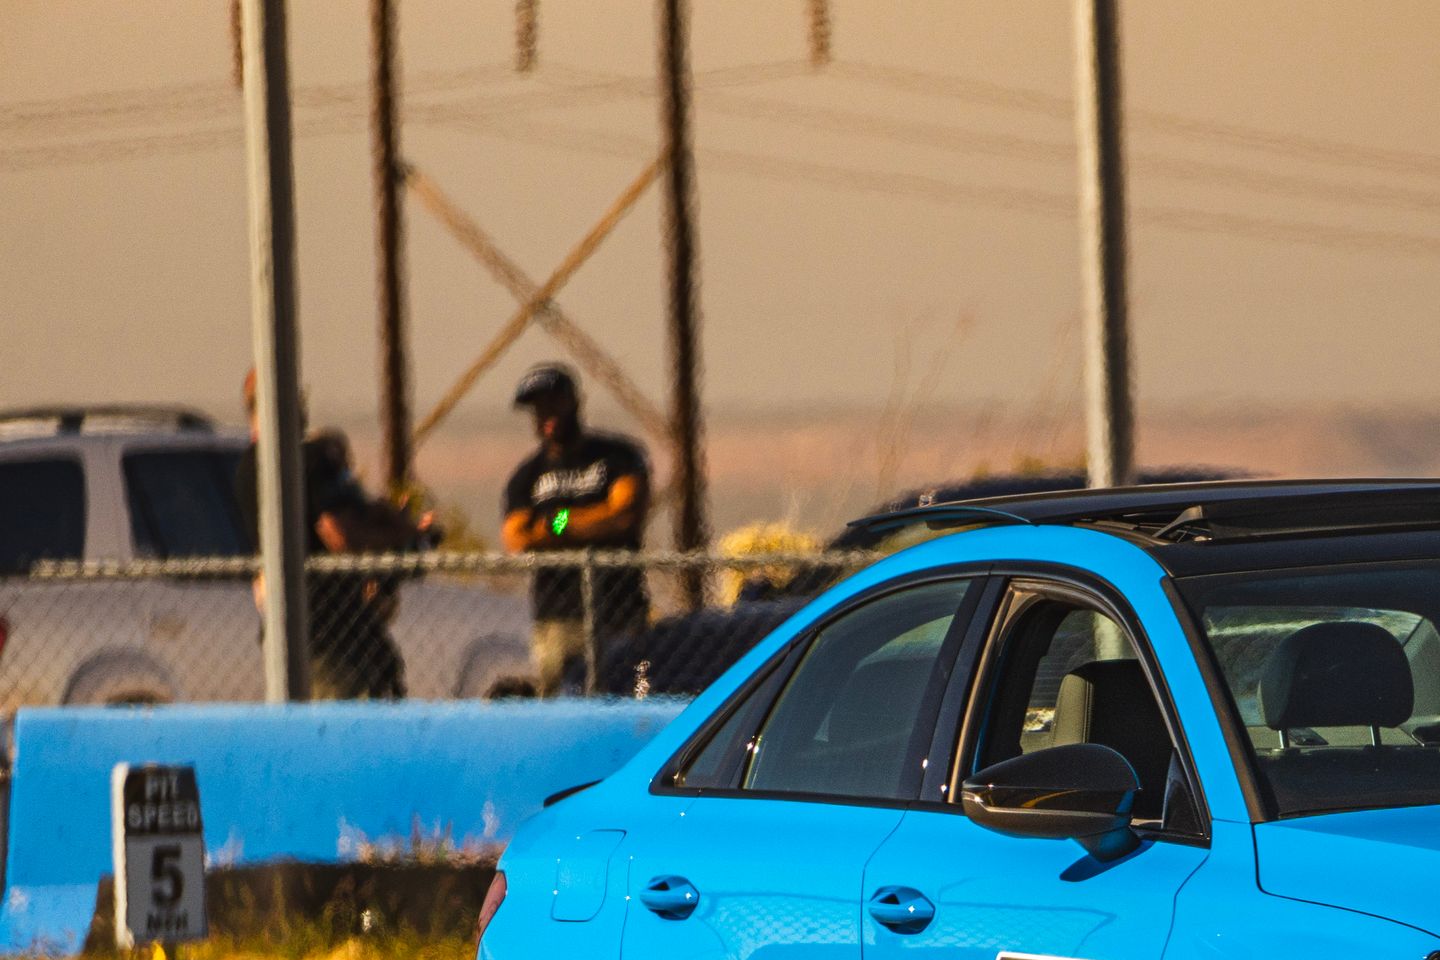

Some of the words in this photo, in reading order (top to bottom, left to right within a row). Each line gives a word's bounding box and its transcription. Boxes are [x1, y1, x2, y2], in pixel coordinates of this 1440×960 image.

[145, 774, 179, 799] PIT
[128, 803, 198, 828] SPEED
[151, 845, 185, 905] 5
